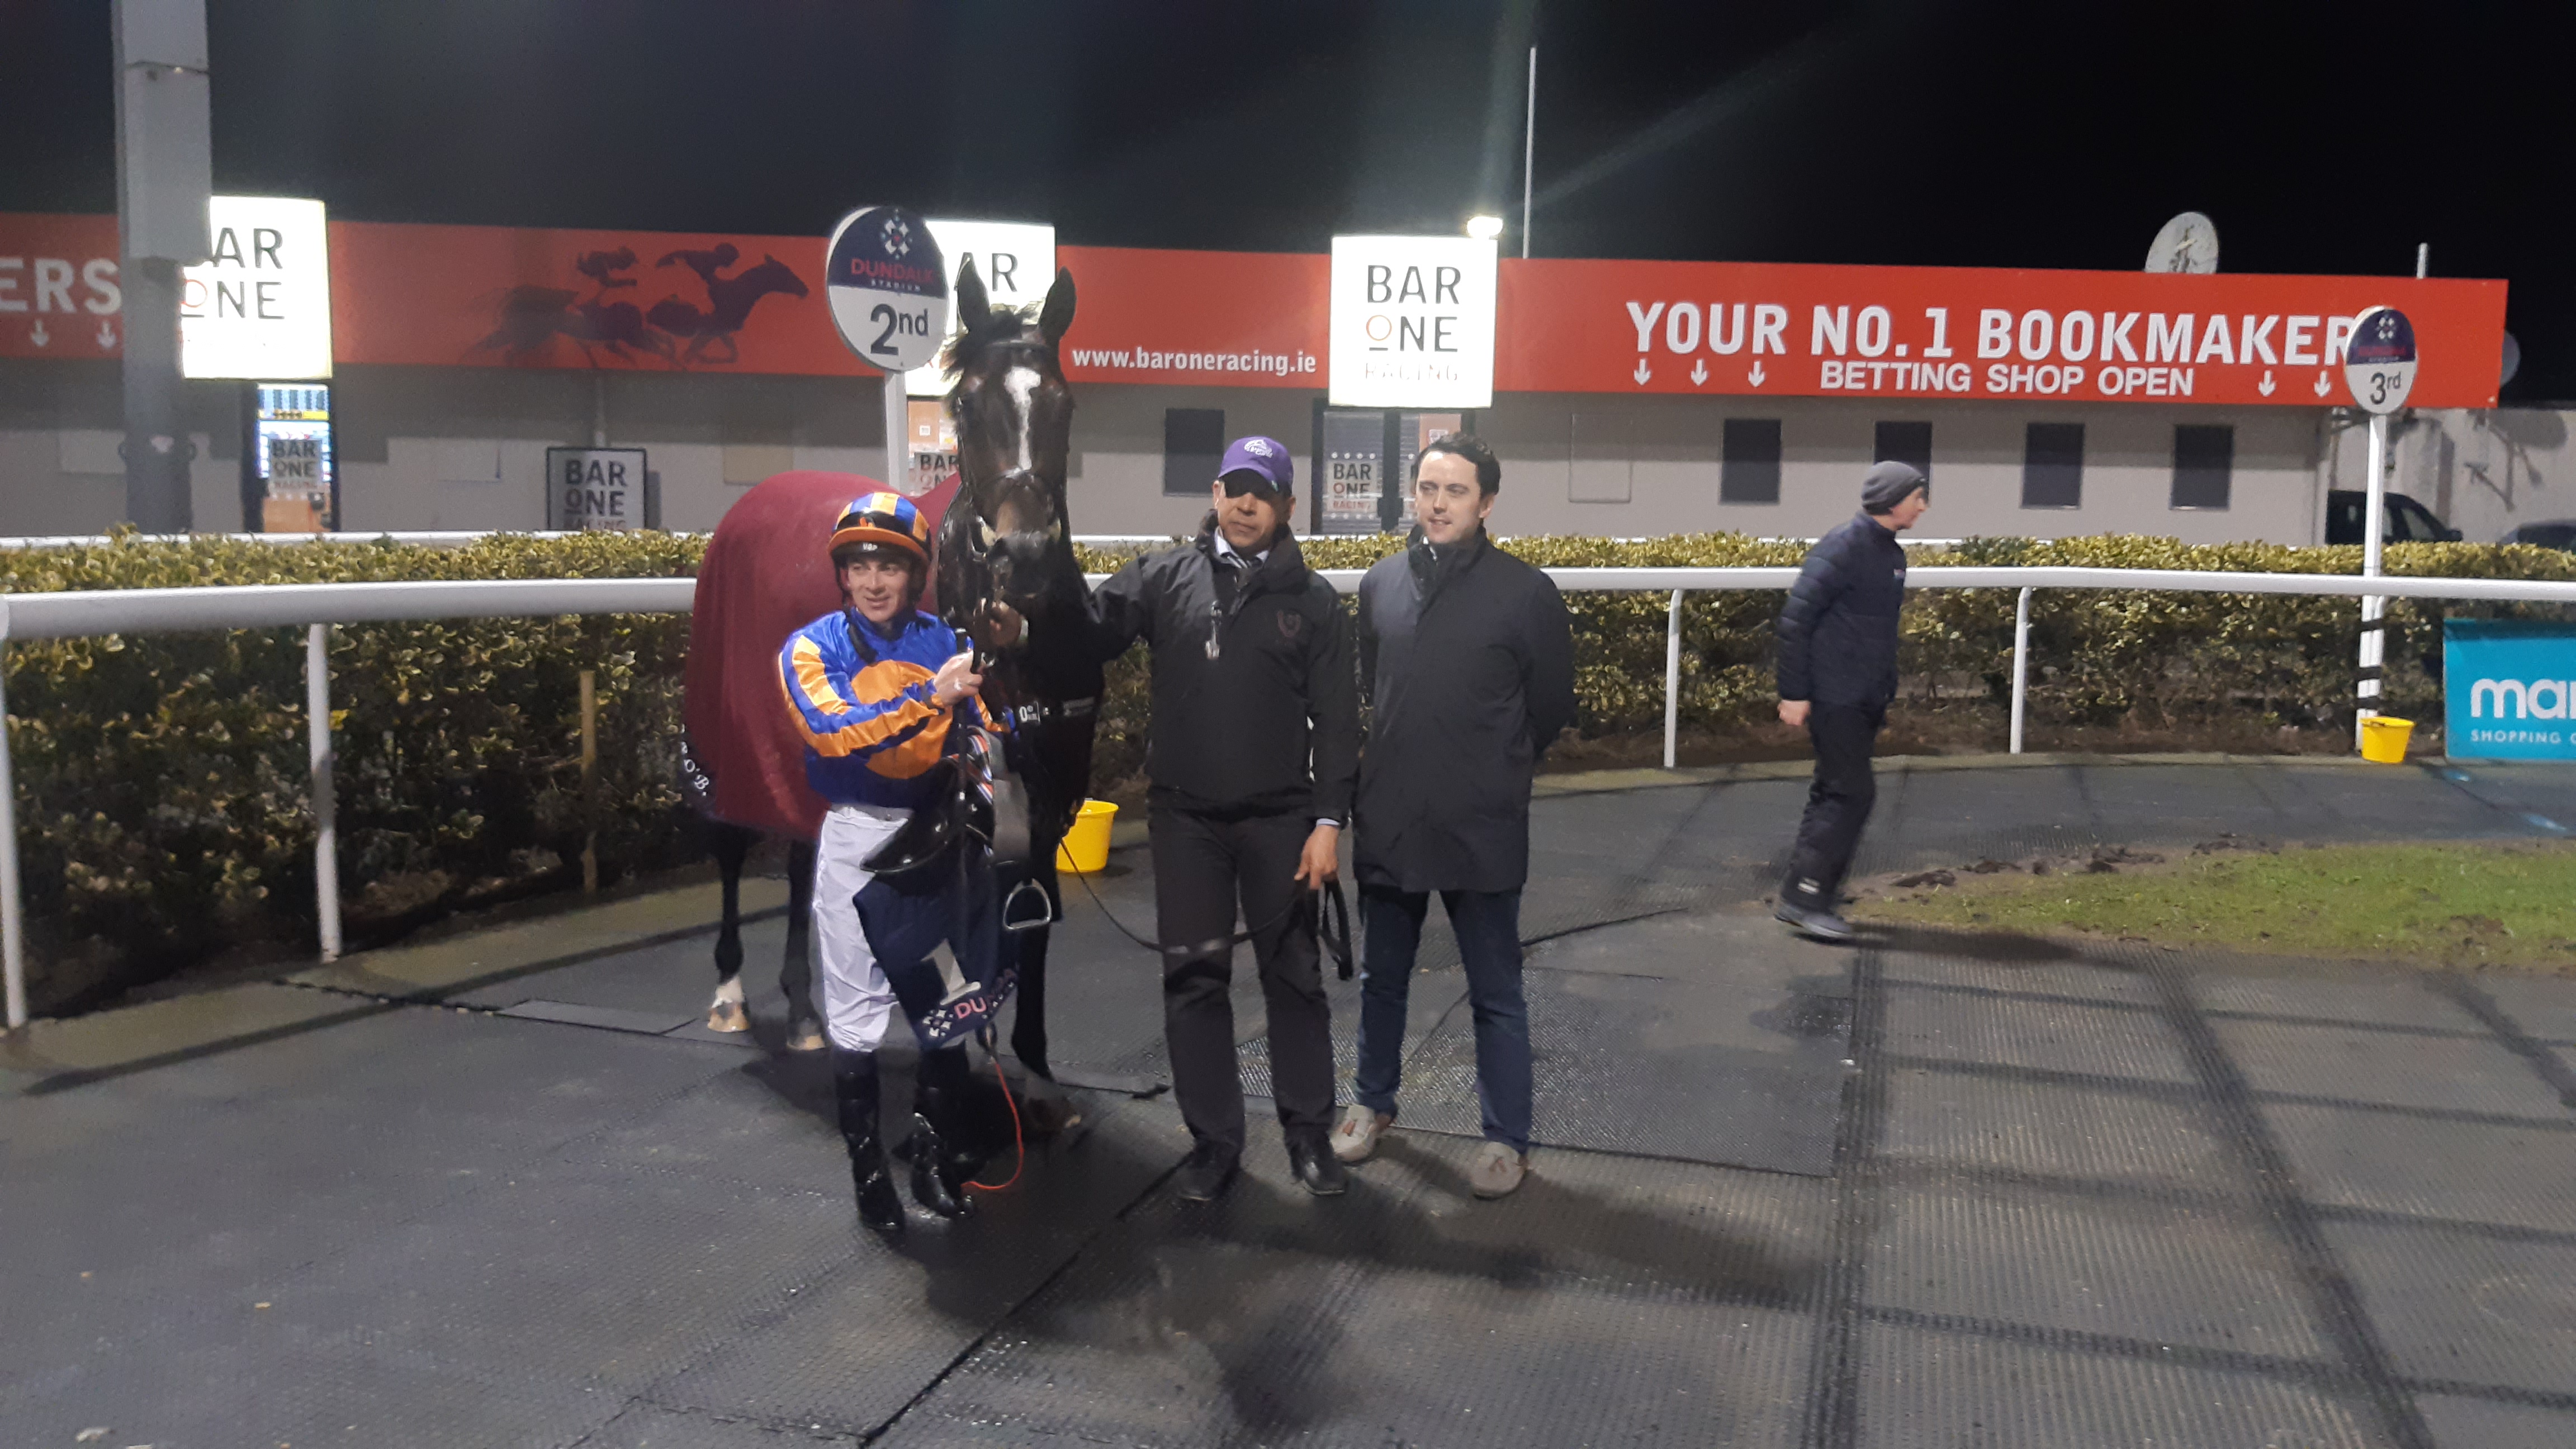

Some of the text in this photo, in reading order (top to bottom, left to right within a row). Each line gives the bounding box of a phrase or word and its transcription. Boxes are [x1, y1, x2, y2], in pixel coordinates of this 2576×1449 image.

[212, 227, 283, 269] AR
[1367, 264, 1461, 305] BAR
[870, 304, 929, 356] 2nd
[1366, 314, 1458, 352] ONE
[1626, 301, 1789, 354] YOUR
[1810, 305, 1953, 358] NO.1
[1071, 346, 1317, 377] www.baroneracing.ie
[1365, 362, 1458, 381] RACING
[1820, 360, 2194, 397] BETTING SHOP OPEN
[2369, 371, 2401, 405] 3rd
[272, 439, 316, 458] BAR
[274, 461, 316, 477] ONE
[565, 459, 628, 487] BAR
[1333, 463, 1371, 480] BAR
[565, 488, 625, 516] ONE
[1333, 482, 1371, 499] ONE
[2470, 729, 2563, 745] SHOPPING
